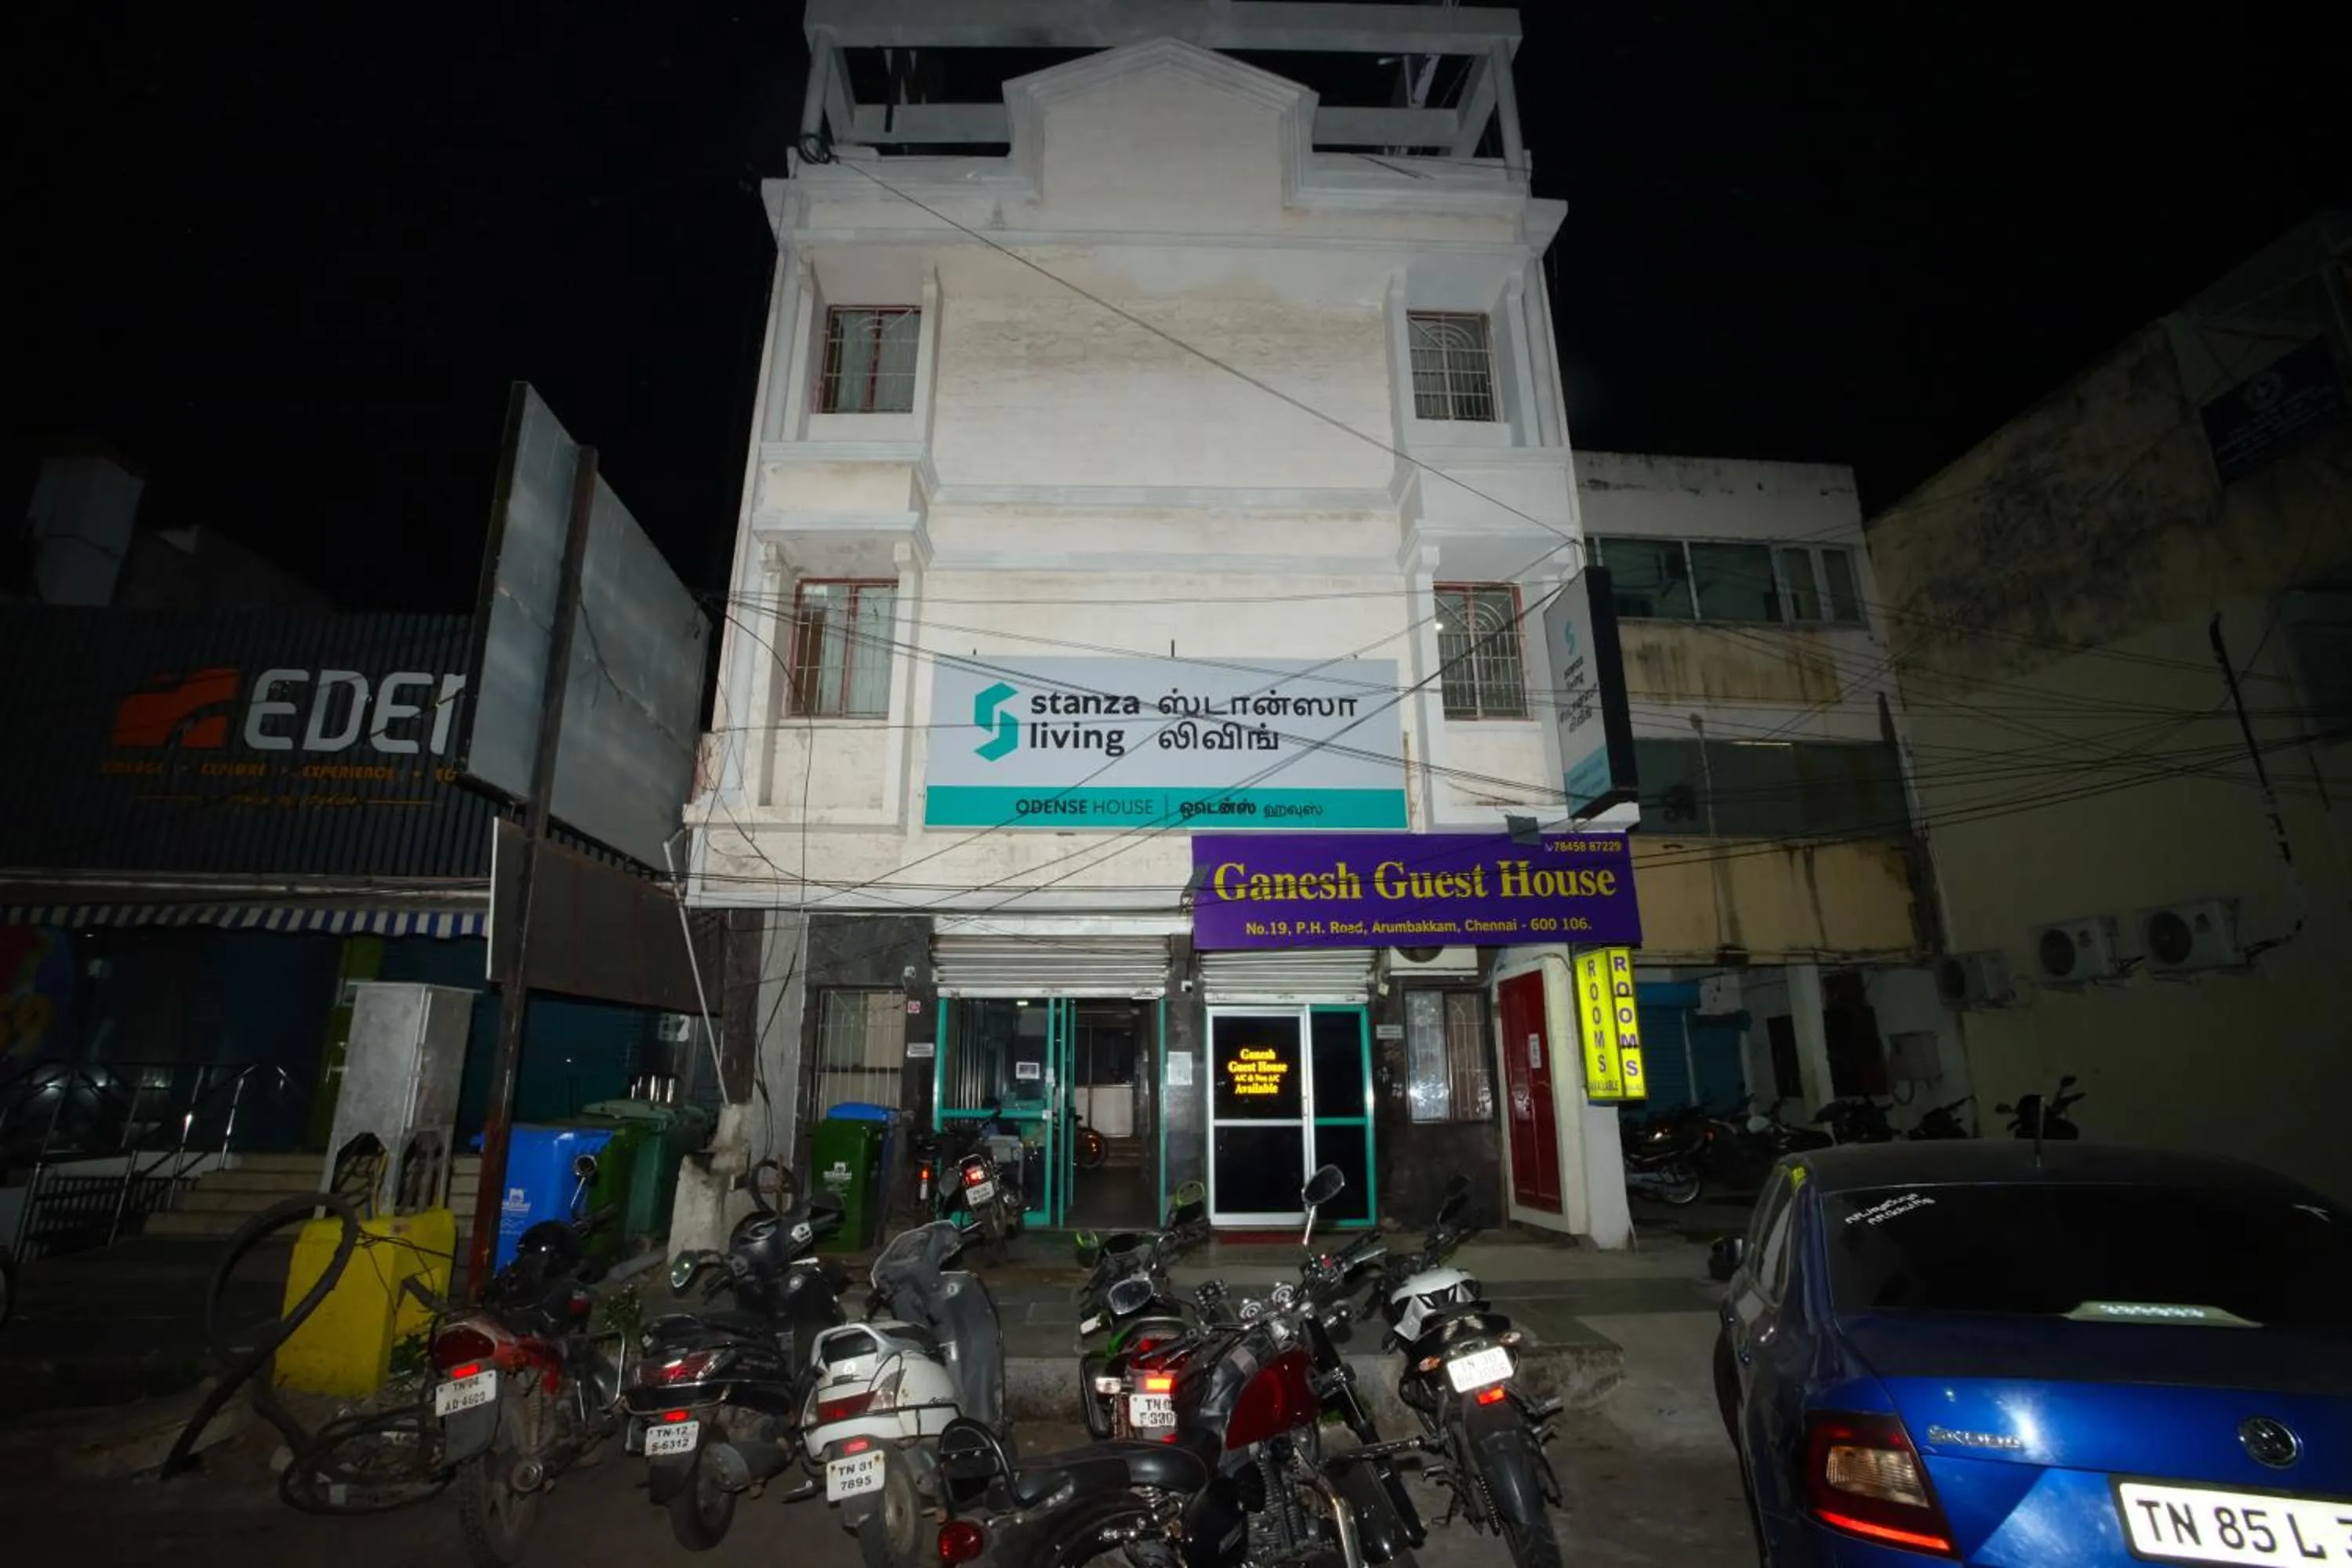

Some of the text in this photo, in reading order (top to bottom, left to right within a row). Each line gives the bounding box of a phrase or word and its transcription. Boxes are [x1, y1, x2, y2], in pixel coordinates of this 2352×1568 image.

[1030, 691, 1141, 715] stanza
[1158, 688, 1358, 717] ஸ்டான்ஸா
[1029, 722, 1125, 757] living
[1158, 722, 1279, 750] லிவிங்
[1015, 799, 1154, 815] ODENSE HOUSE
[1214, 860, 1617, 901] Ganesh Guest House
[1330, 921, 1368, 935] Road,
[1372, 919, 1461, 934] Arumbakkam,
[1465, 919, 1517, 931] Chennai
[1530, 918, 1557, 931] 600
[1587, 959, 1606, 1073] ROOMS
[1613, 956, 1639, 1076] ROOMS
[1228, 1061, 1288, 1073] Guest House
[2136, 1499, 2202, 1545] TN
[2213, 1506, 2277, 1553] 85
[2286, 1513, 2328, 1559] L
